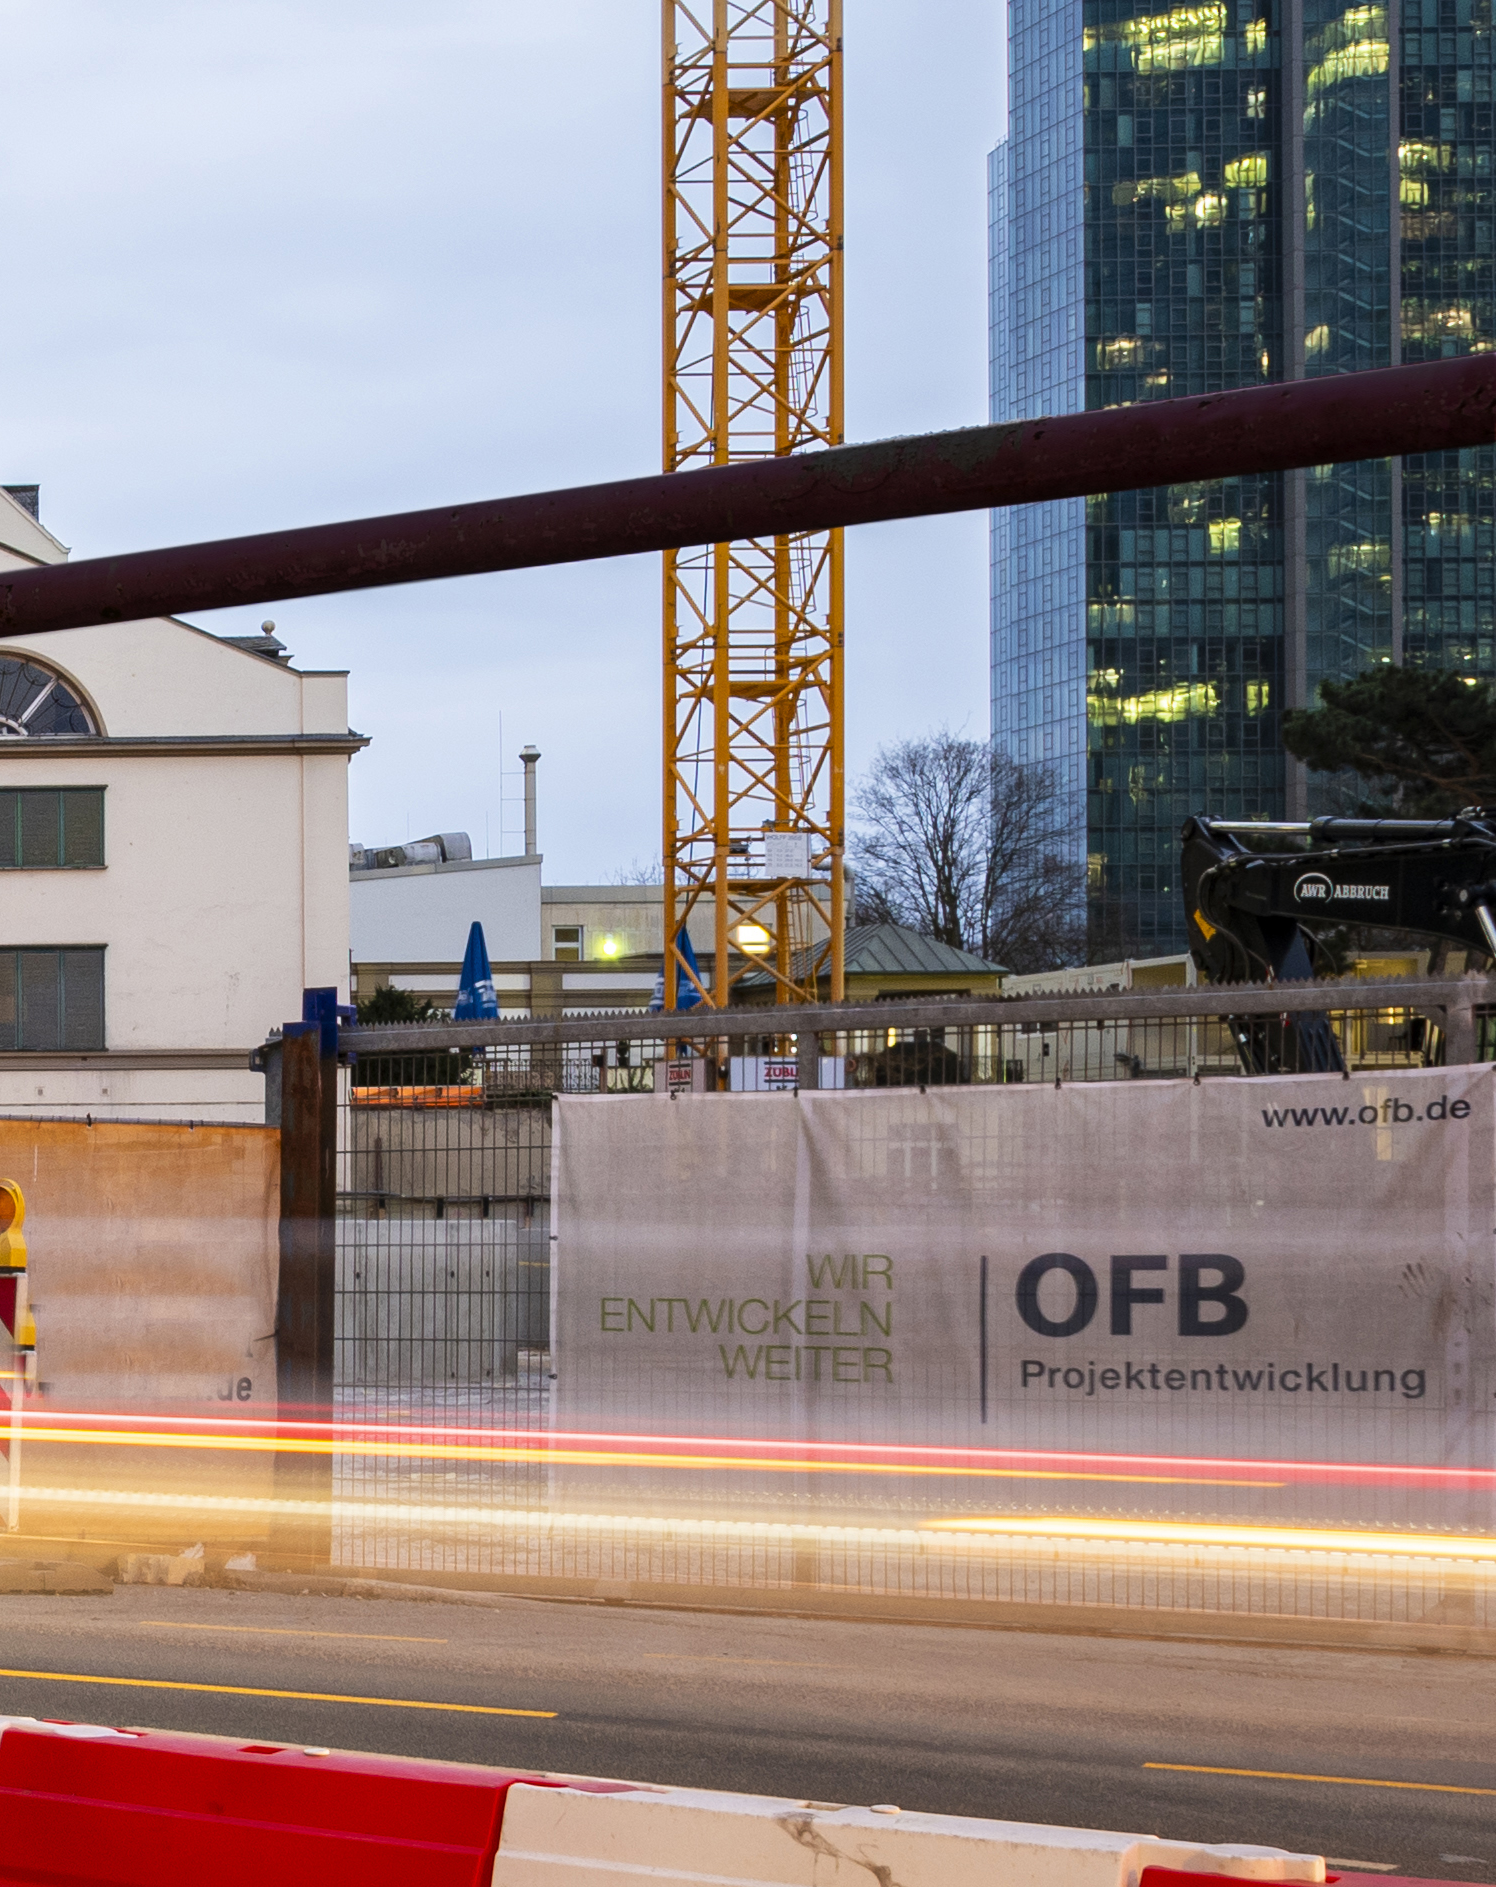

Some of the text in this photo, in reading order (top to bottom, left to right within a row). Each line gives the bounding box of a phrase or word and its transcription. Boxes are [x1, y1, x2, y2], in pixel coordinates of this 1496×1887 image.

[1300, 884, 1389, 899] AWR ABBRUCH
[1261, 1095, 1472, 1127] www.ofb.de
[806, 1254, 895, 1290] WIR
[1015, 1252, 1249, 1338] OFB
[600, 1297, 893, 1337] ENTWICKELN
[718, 1343, 895, 1383] WEITER
[1020, 1359, 1427, 1399] Projektentwicklung
